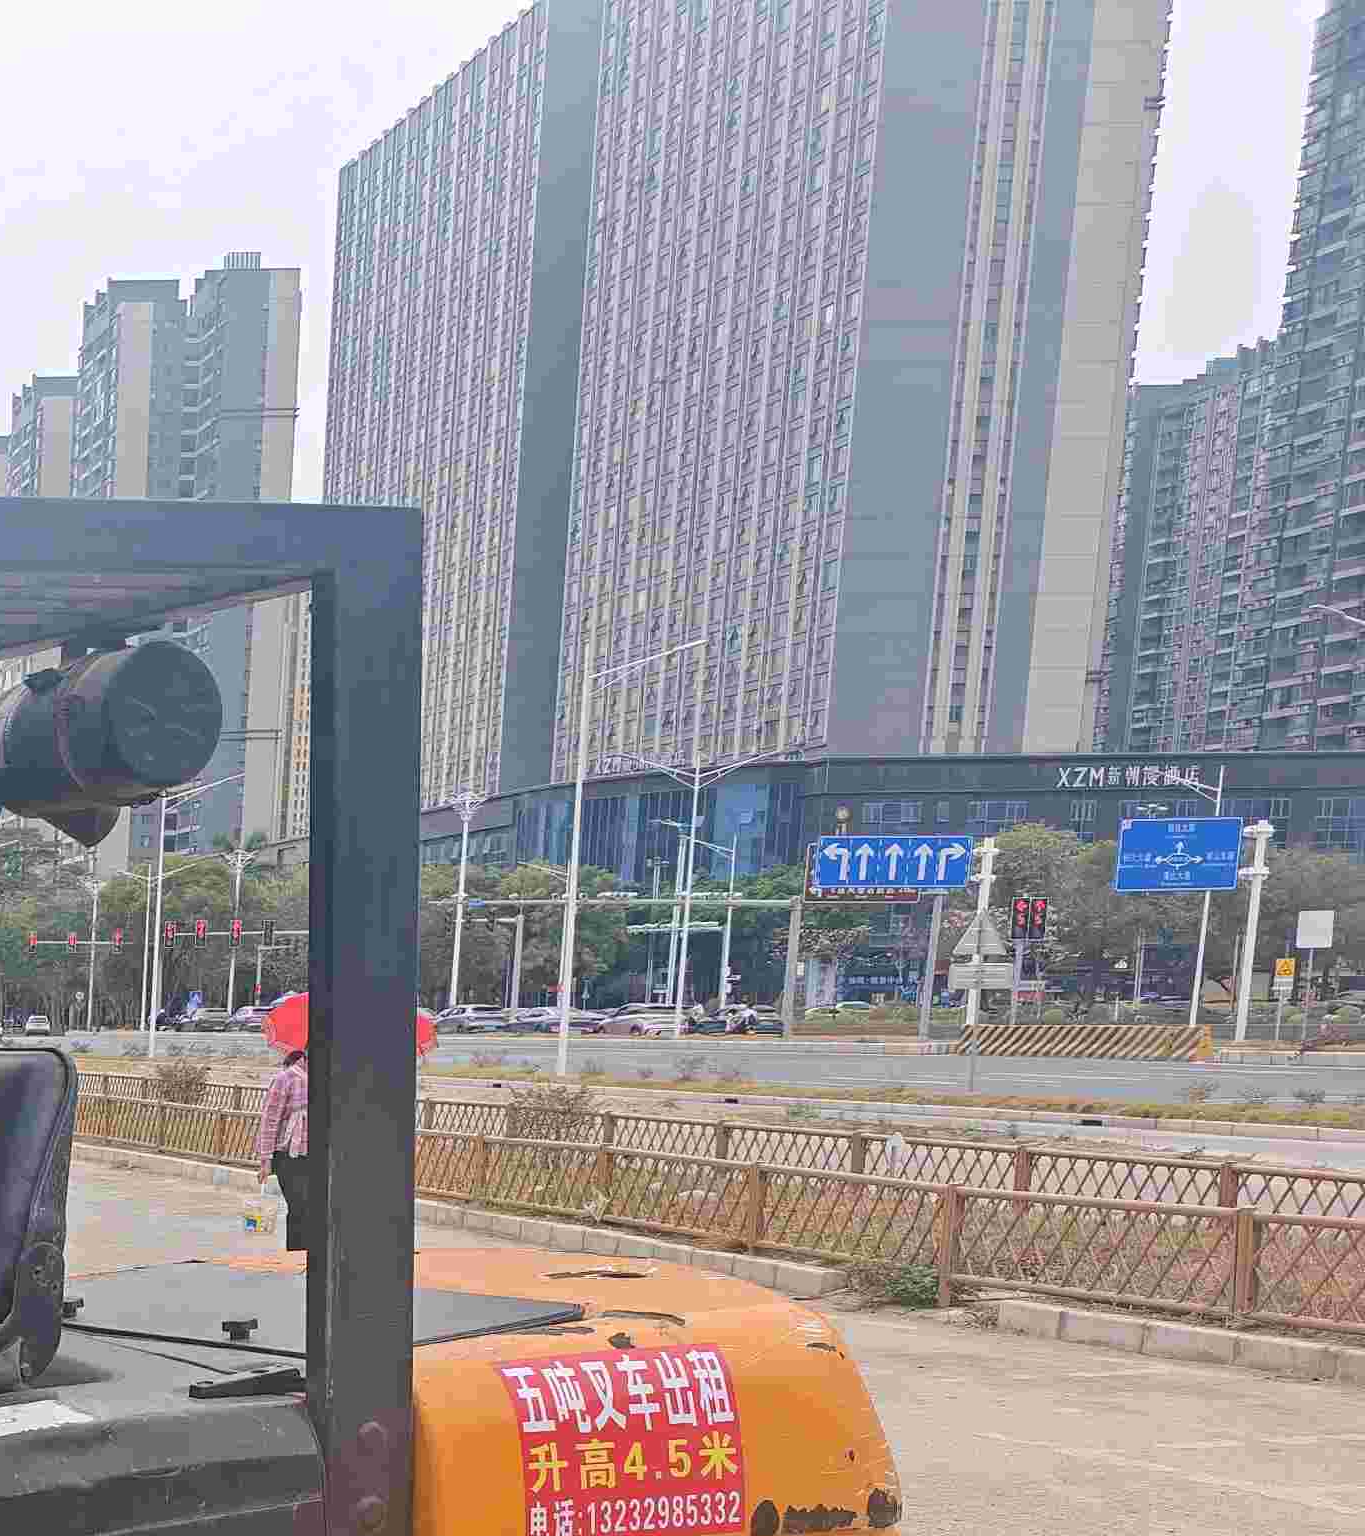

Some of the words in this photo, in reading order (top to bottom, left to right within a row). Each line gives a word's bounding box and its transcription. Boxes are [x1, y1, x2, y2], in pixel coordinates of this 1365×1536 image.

[1055, 766, 1105, 788] XZM
[500, 1349, 736, 1434] 五吨叉车出租
[527, 1430, 740, 1493] 升高4.5米
